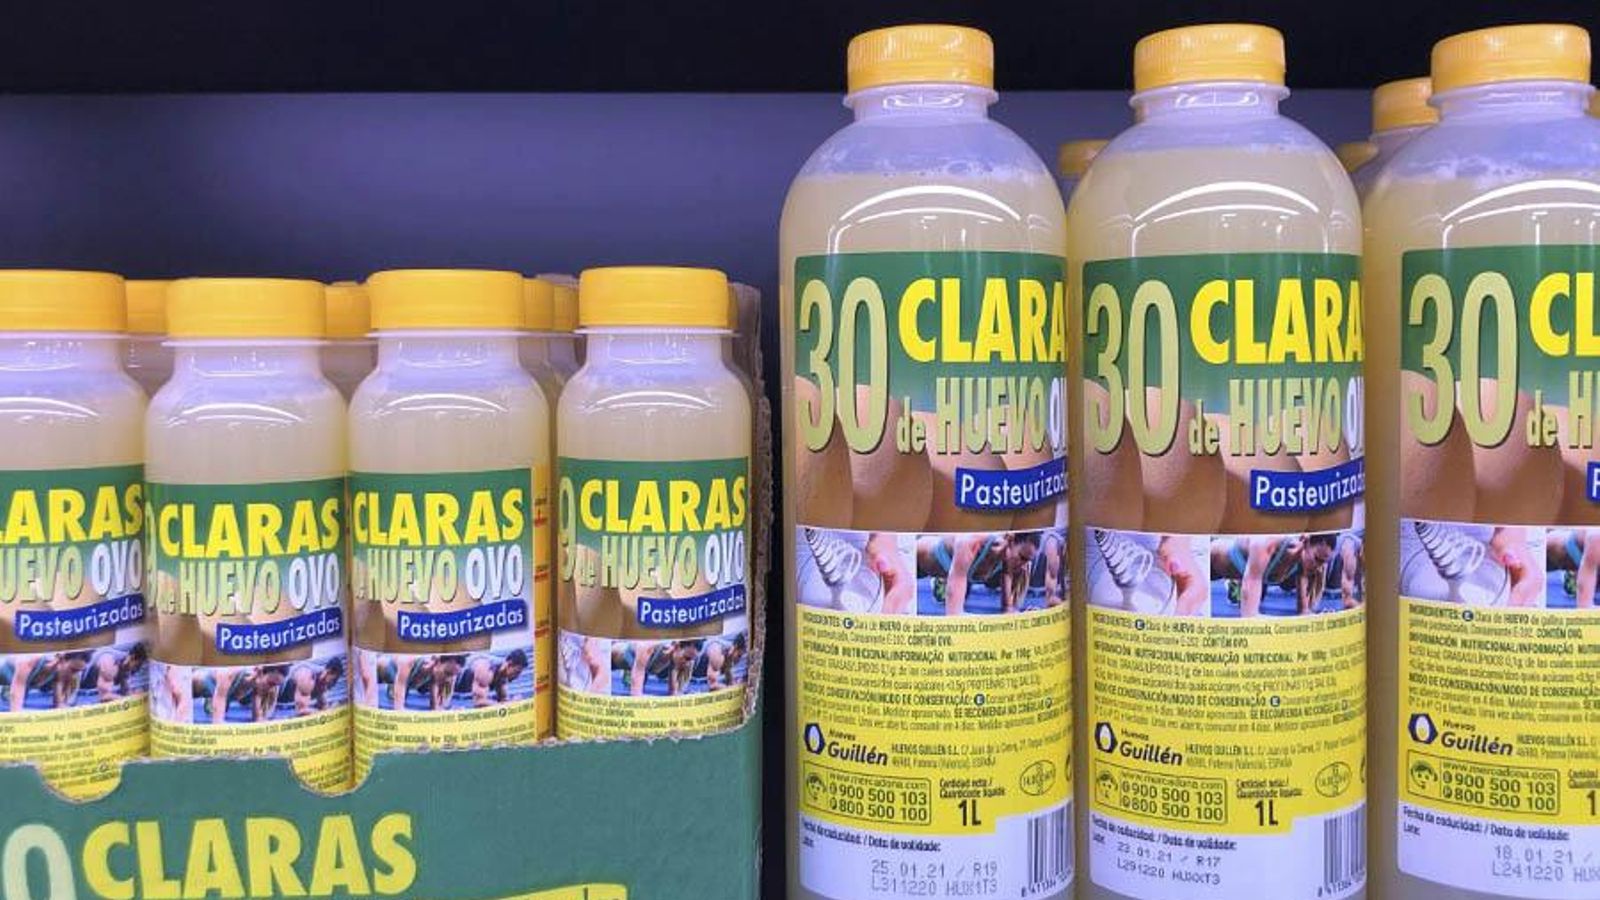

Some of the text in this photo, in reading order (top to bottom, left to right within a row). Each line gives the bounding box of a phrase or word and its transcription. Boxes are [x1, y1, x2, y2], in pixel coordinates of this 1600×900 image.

[799, 276, 890, 455] 30
[1086, 279, 1181, 457] 30
[1408, 271, 1519, 448] 30
[896, 396, 927, 455] de
[936, 375, 1046, 455] HUEVO
[1188, 399, 1220, 456] de
[1229, 376, 1343, 457] HUEVO
[1526, 389, 1559, 448] de
[353, 487, 525, 547] CLARAS
[580, 476, 746, 533] CLARAS
[159, 498, 340, 560] CLARAS
[91, 539, 142, 598] OVO
[367, 543, 525, 604] HUEVO OVO
[602, 534, 698, 589] HUEVO
[703, 530, 745, 587] OVO
[179, 552, 341, 618] HUEVO OVO
[19, 601, 143, 638] Pasteurizadas
[400, 605, 525, 640] Pasteurizadas
[640, 590, 745, 625] Pasteurizadas
[219, 612, 341, 651] Pasteurizadas
[827, 740, 889, 767] Guillén
[1119, 740, 1184, 767] Guillén
[1440, 731, 1514, 757] Guillén
[839, 784, 928, 806] 900 500 103
[1131, 781, 1224, 806] 900 500 103
[1454, 787, 1556, 811] 800 500 100
[1455, 773, 1485, 790] 900
[1489, 777, 1520, 794] 500
[1527, 780, 1557, 797] 103
[839, 798, 928, 822] 800 500 100
[958, 799, 983, 827] 1L
[1131, 797, 1224, 821] 800 500 100
[1255, 800, 1280, 827] 1L
